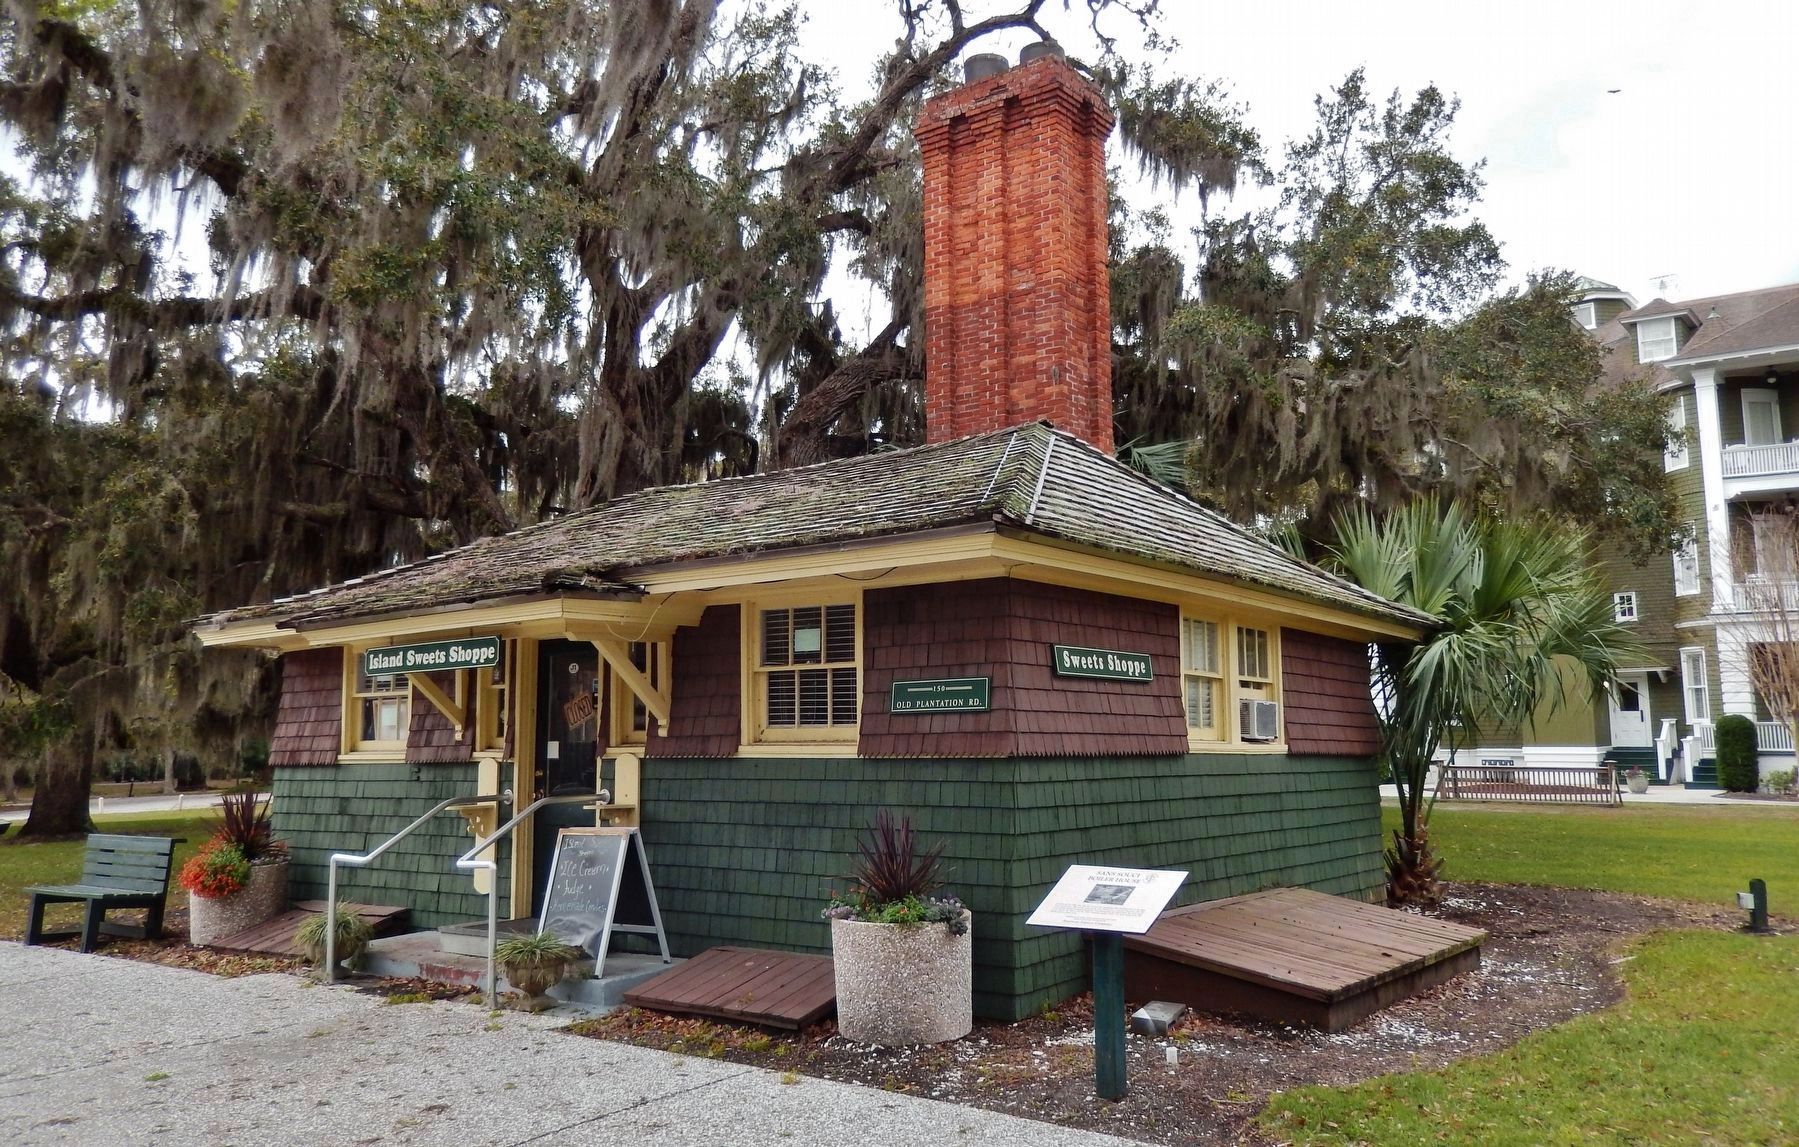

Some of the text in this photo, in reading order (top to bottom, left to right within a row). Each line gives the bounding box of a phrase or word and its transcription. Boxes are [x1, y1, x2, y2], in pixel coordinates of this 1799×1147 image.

[368, 646, 495, 669] Island Sweets Shoppe
[1063, 650, 1146, 677] Sweets Shoppe
[896, 698, 982, 709] OLD PLANTATION RD.
